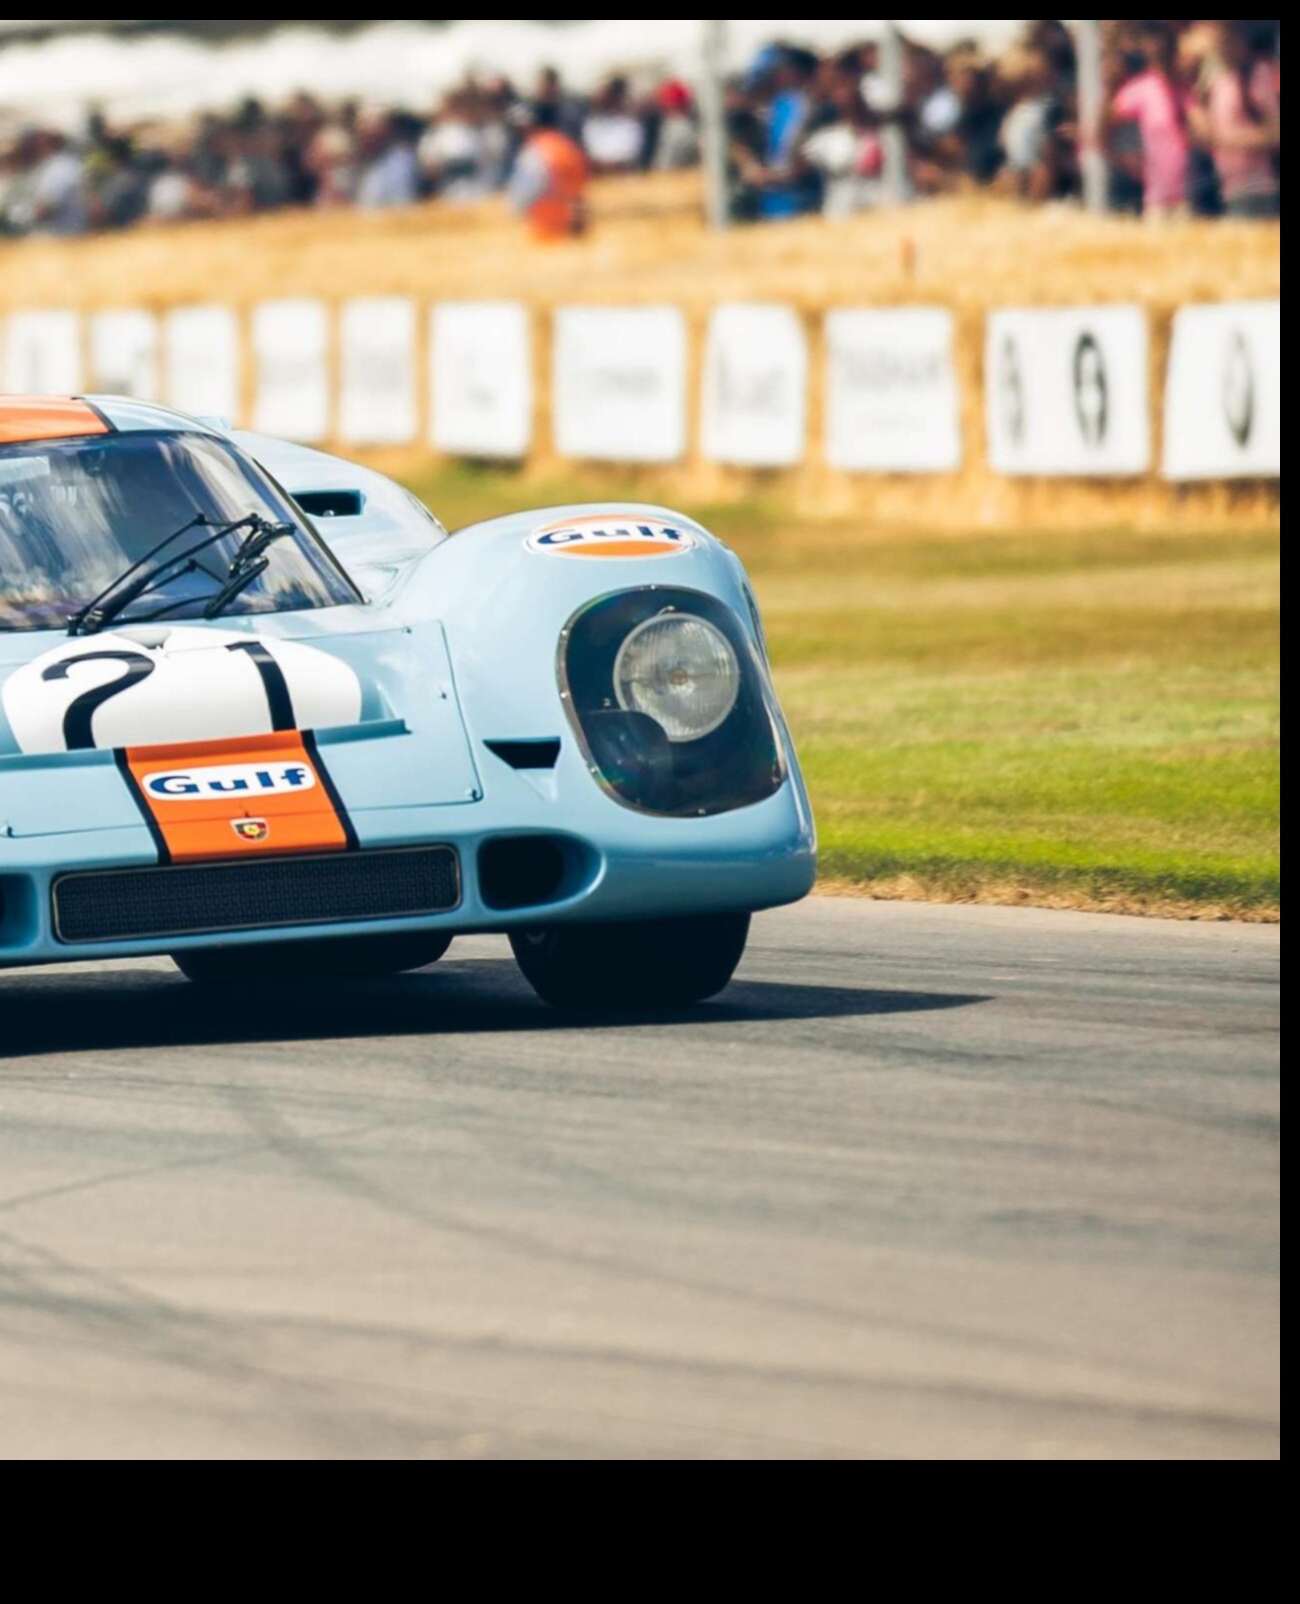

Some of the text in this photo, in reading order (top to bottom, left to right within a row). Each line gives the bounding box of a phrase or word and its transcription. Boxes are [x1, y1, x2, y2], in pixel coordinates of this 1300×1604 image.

[537, 525, 683, 544] Gulf
[41, 641, 297, 751] 21
[149, 768, 306, 795] Gulf
